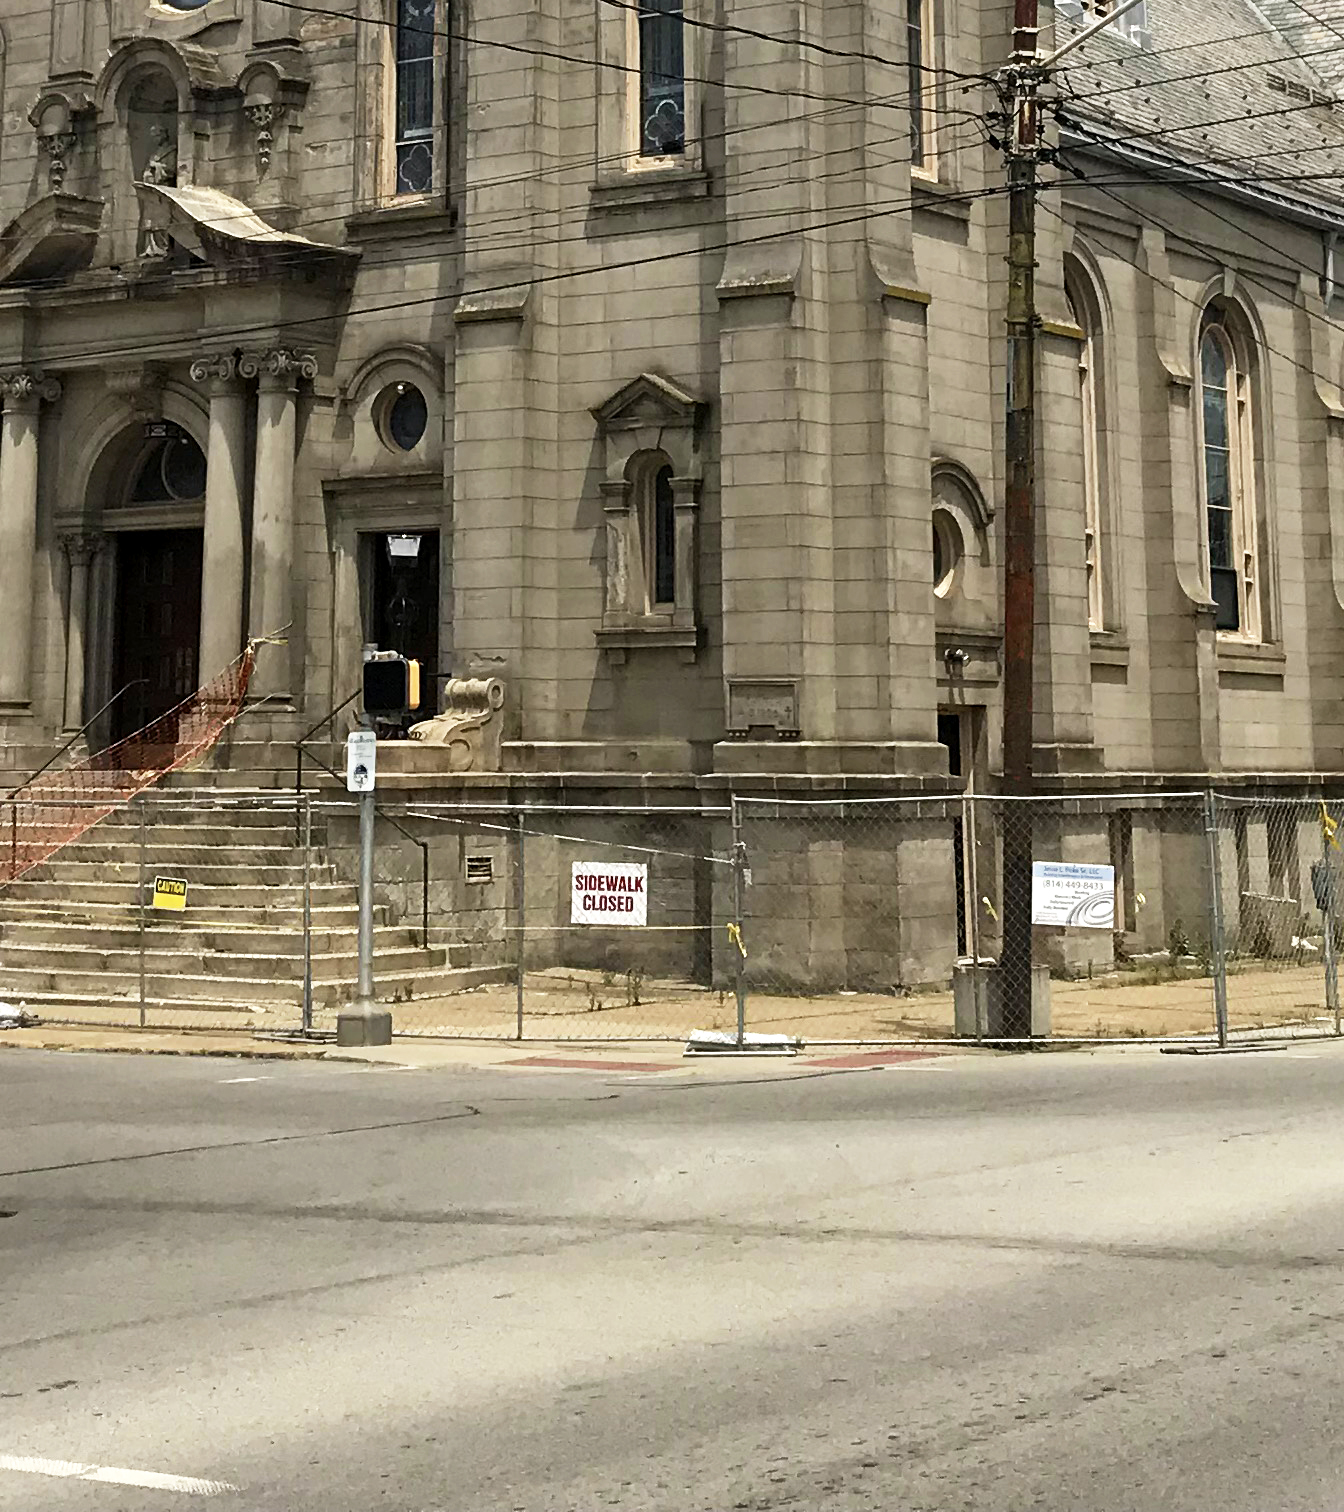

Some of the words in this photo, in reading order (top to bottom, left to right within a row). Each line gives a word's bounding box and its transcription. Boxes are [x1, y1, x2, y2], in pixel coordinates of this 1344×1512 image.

[157, 879, 185, 894] CAUTION
[575, 874, 644, 892] SIDEWALK
[1043, 879, 1064, 889] (814)
[582, 894, 634, 912] CLOSED
